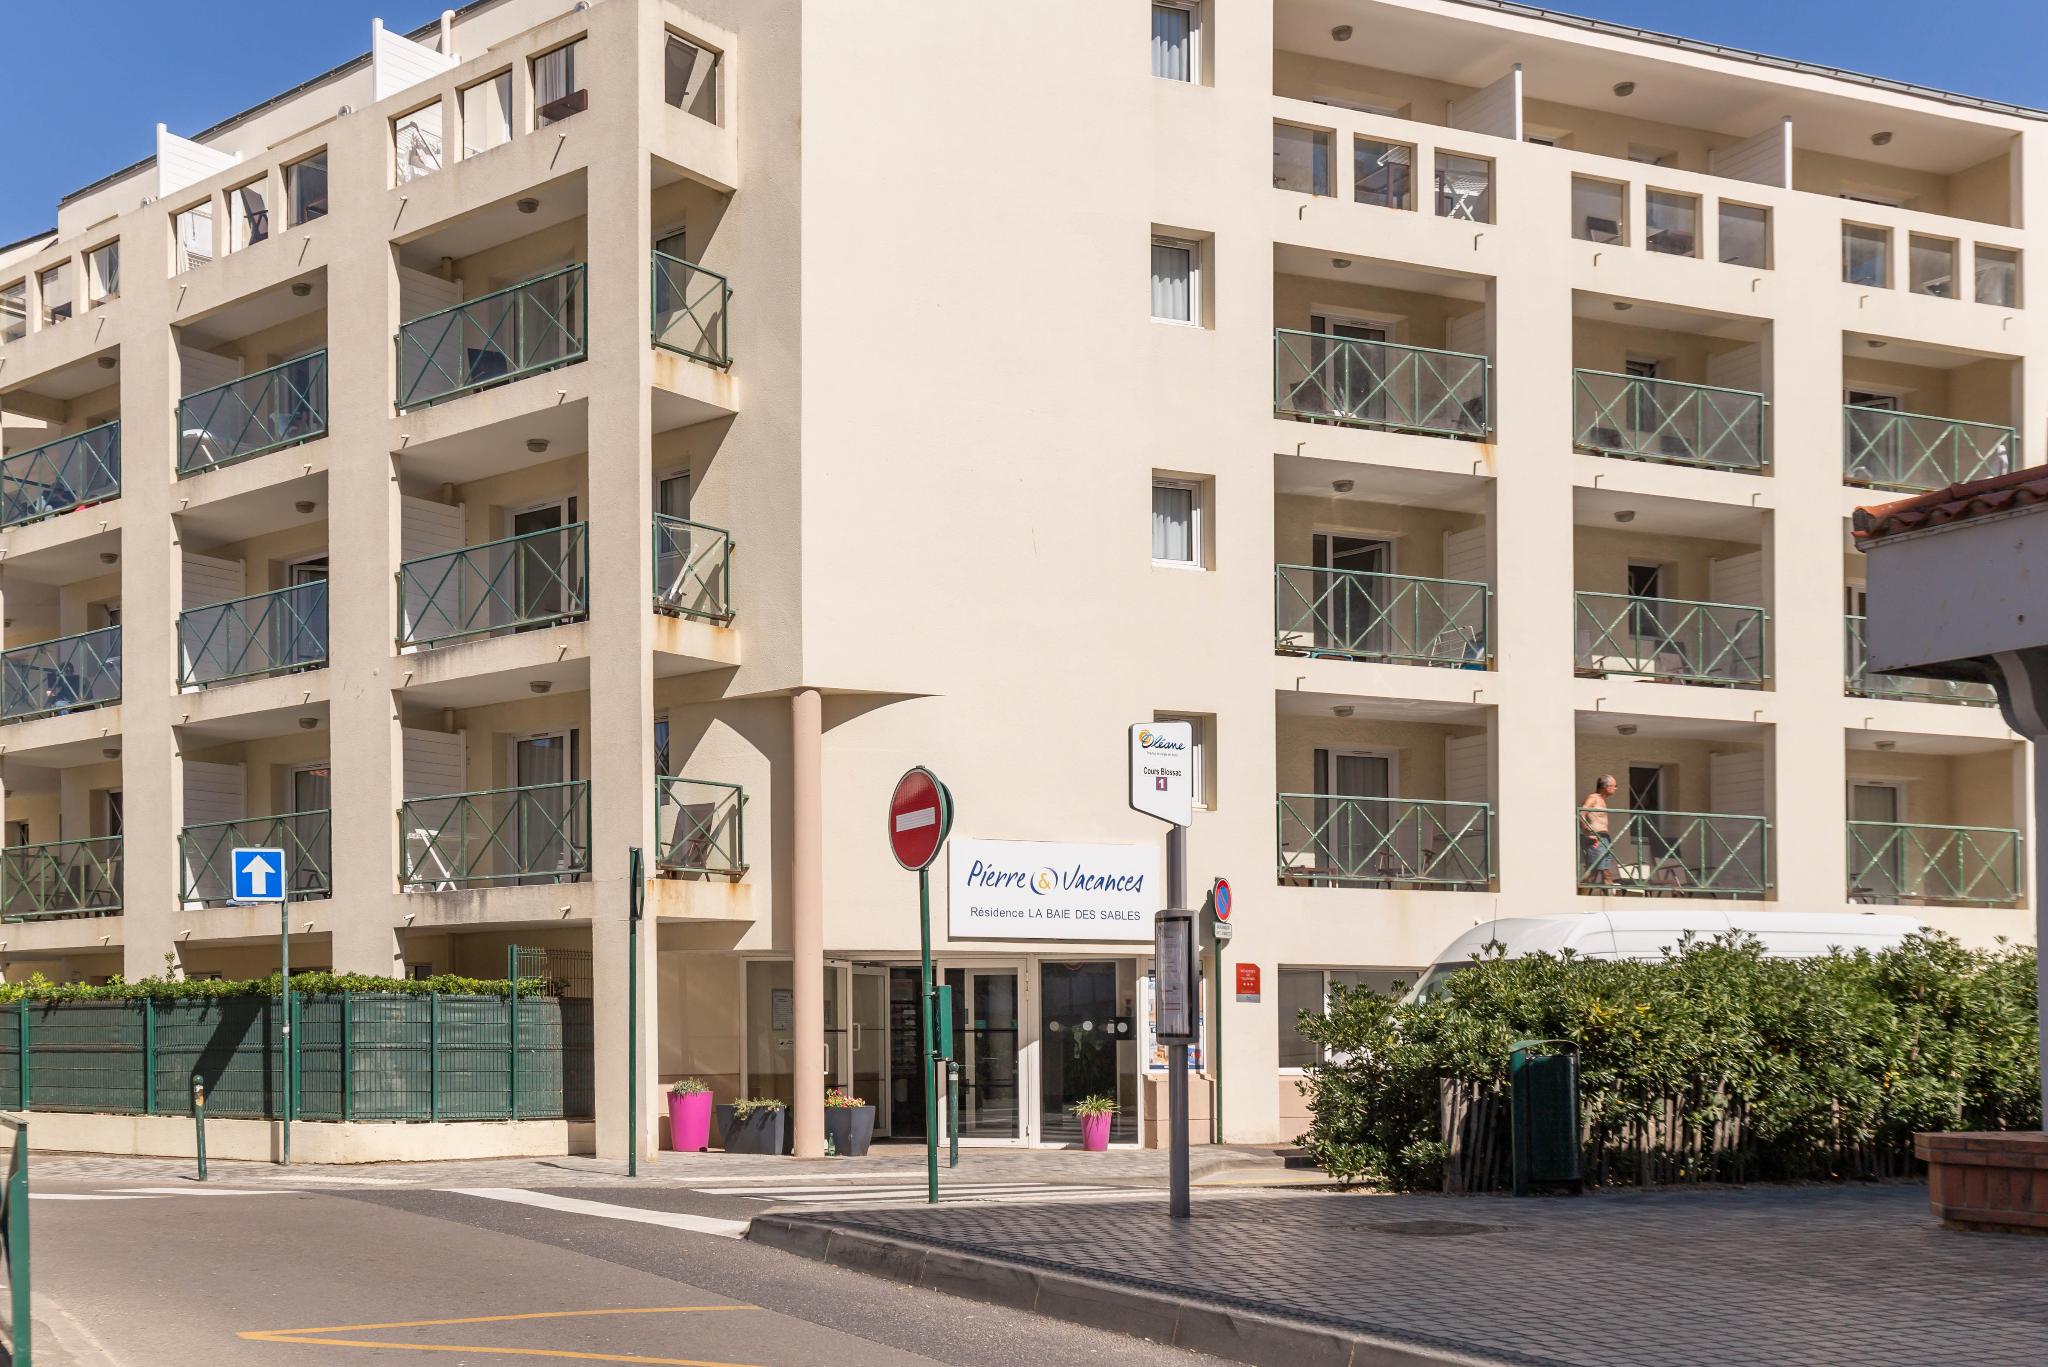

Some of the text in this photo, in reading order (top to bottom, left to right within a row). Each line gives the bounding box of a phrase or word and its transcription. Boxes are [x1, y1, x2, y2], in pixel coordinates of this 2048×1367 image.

[1144, 766, 1159, 776] Cours
[1158, 778, 1165, 789] 1
[967, 859, 1144, 893] Pierre & Vacances
[970, 906, 1141, 921] Résidence LA BAIE DES SABLES
